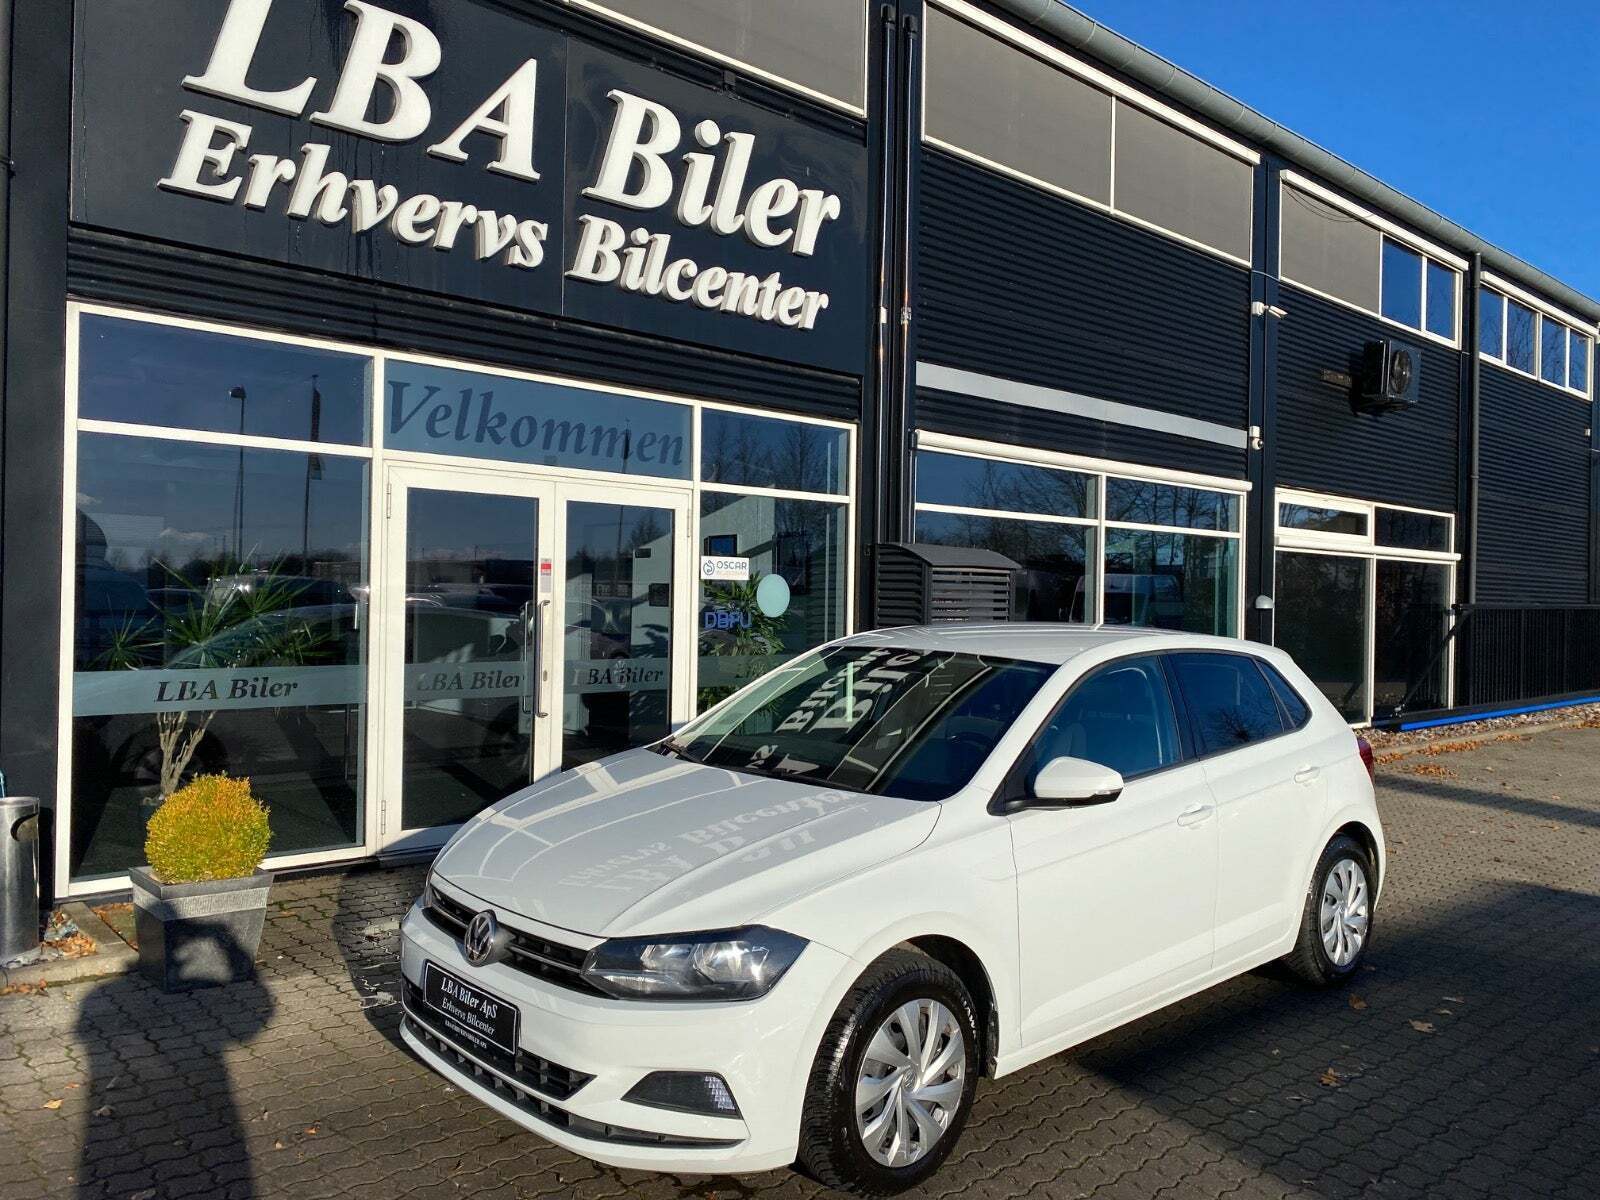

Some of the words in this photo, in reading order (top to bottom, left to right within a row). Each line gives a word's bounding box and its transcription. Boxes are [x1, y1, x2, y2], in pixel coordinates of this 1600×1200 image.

[182, 0, 540, 183] LBA
[582, 88, 841, 256] Biler
[157, 109, 548, 269] Erhvervs
[565, 213, 828, 331] Bilcenter
[387, 380, 685, 466] Velkommen
[716, 560, 747, 571] OSCAR
[154, 679, 218, 702] LBA
[226, 676, 298, 699] Biler
[470, 670, 525, 690] Biler
[618, 668, 664, 685] Biler
[440, 977, 459, 998] LBA
[459, 986, 480, 1009] Biler
[479, 999, 499, 1019] ApS
[467, 1011, 496, 1037] Bilcenter
